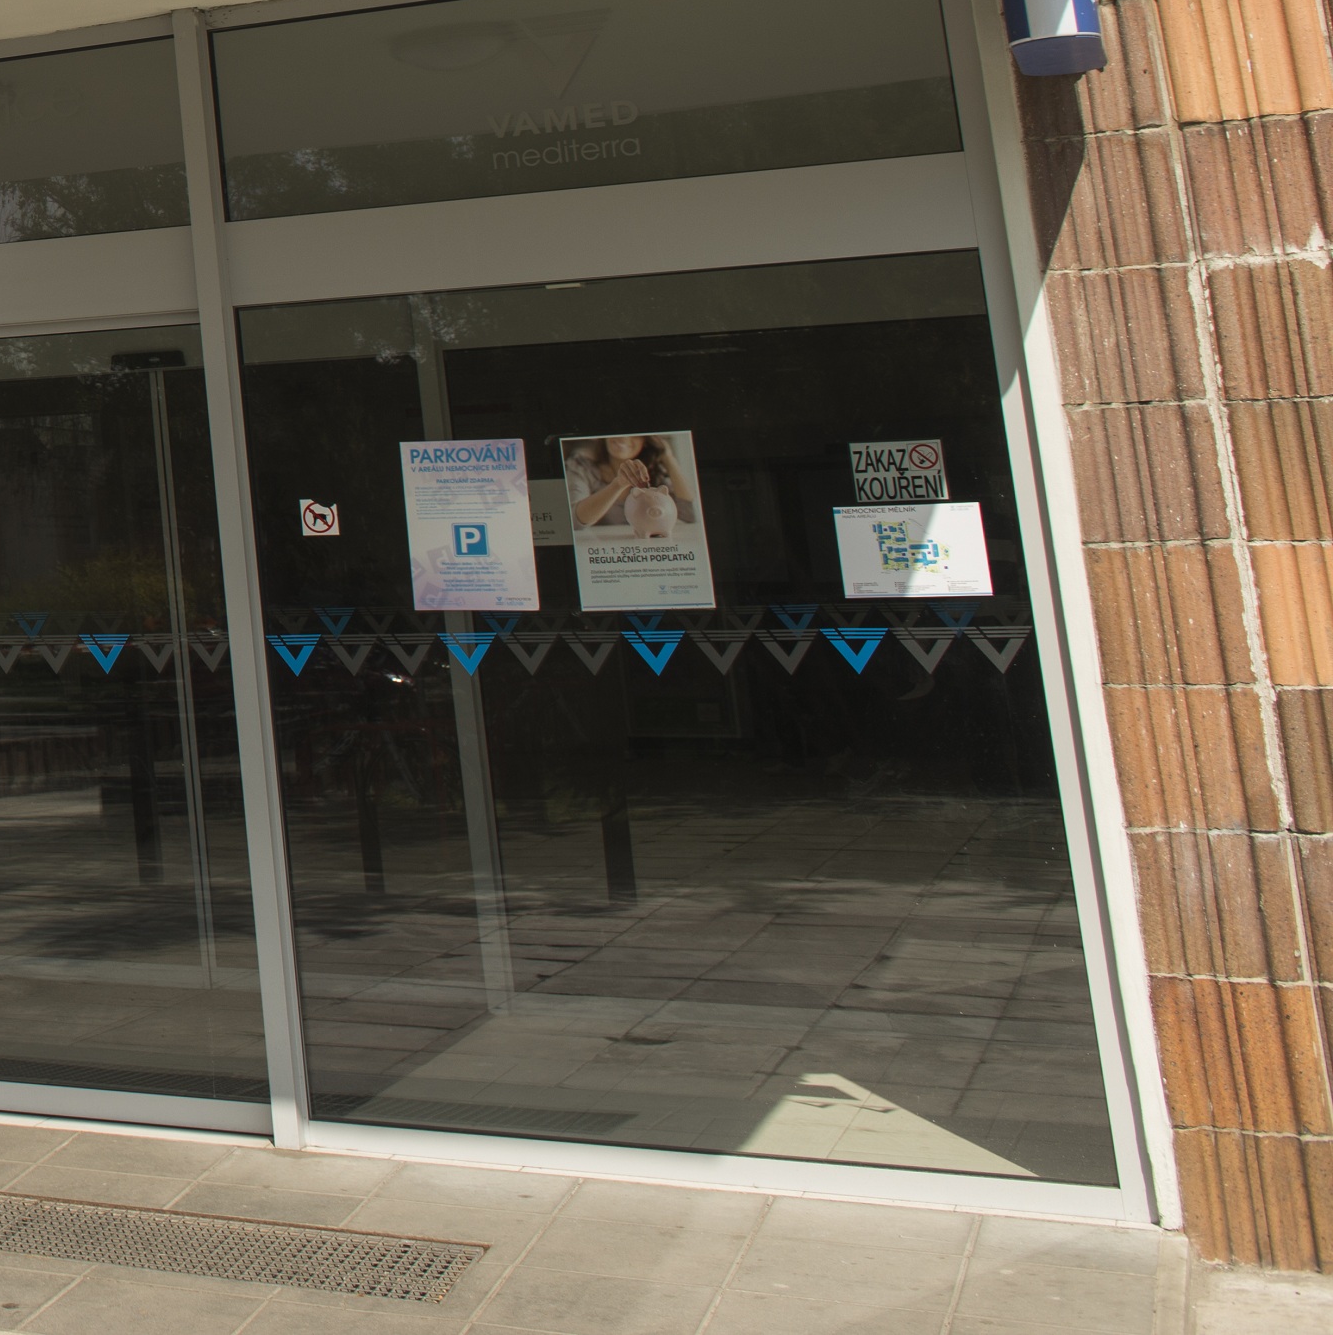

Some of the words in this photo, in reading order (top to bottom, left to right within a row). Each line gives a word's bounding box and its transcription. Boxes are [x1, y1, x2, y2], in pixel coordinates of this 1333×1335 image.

[485, 99, 640, 139] VAMED
[492, 137, 642, 170] mediterra
[409, 443, 517, 464] PARKOVÁNÍ
[852, 445, 909, 474] ZÁKAZ
[445, 465, 490, 473] NEMOCNICE
[855, 470, 945, 502] KOUŘENÍ
[841, 507, 886, 515] NEMOCNICE
[887, 505, 917, 513] MĚLNÍK
[587, 547, 599, 556] Od
[620, 546, 641, 554] 2015
[642, 544, 679, 554] omezení
[589, 553, 648, 565] REGULAČNÍCH
[650, 551, 695, 562] POPLATKŮ
